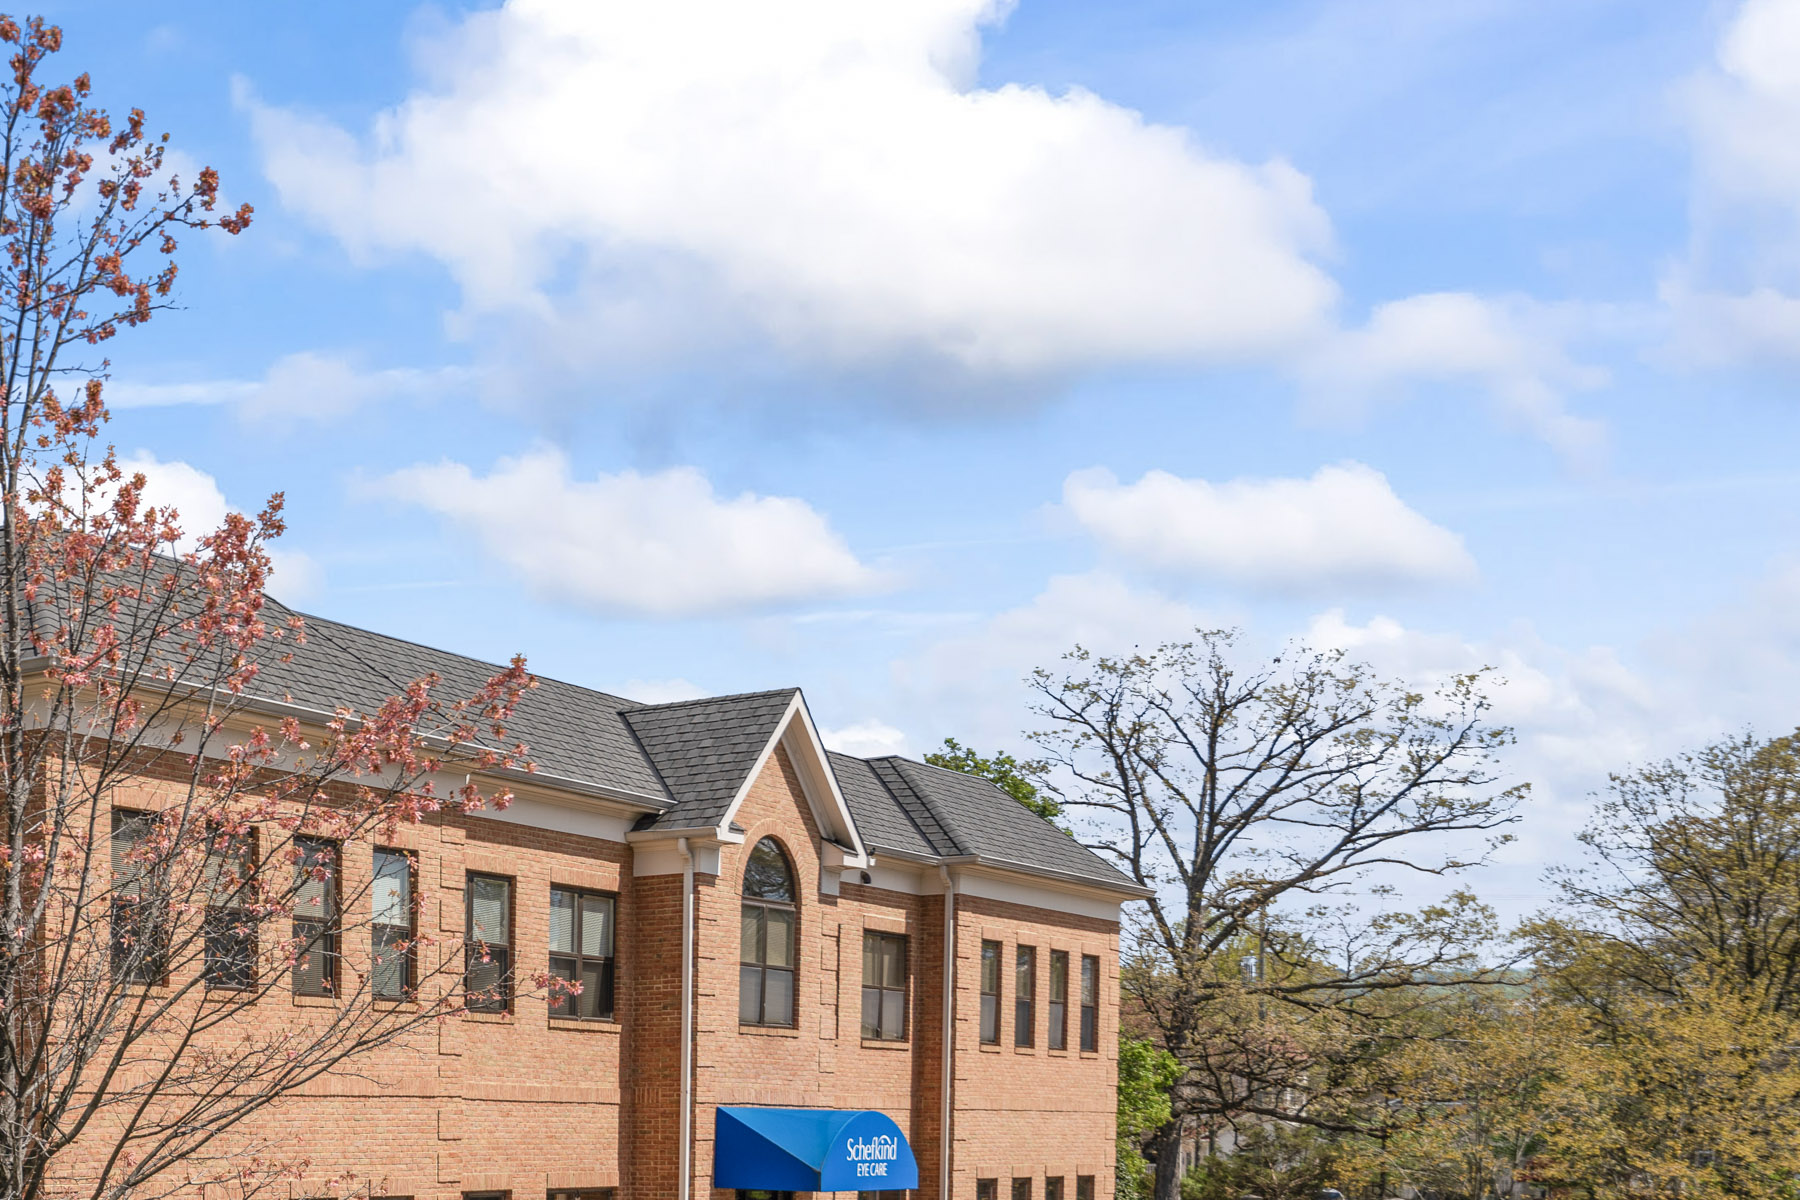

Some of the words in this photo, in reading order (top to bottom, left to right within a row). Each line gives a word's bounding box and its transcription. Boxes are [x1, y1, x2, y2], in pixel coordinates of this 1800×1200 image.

[846, 1135, 898, 1161] Schefkind
[857, 1162, 870, 1176] EYE
[870, 1162, 888, 1176] CARE
